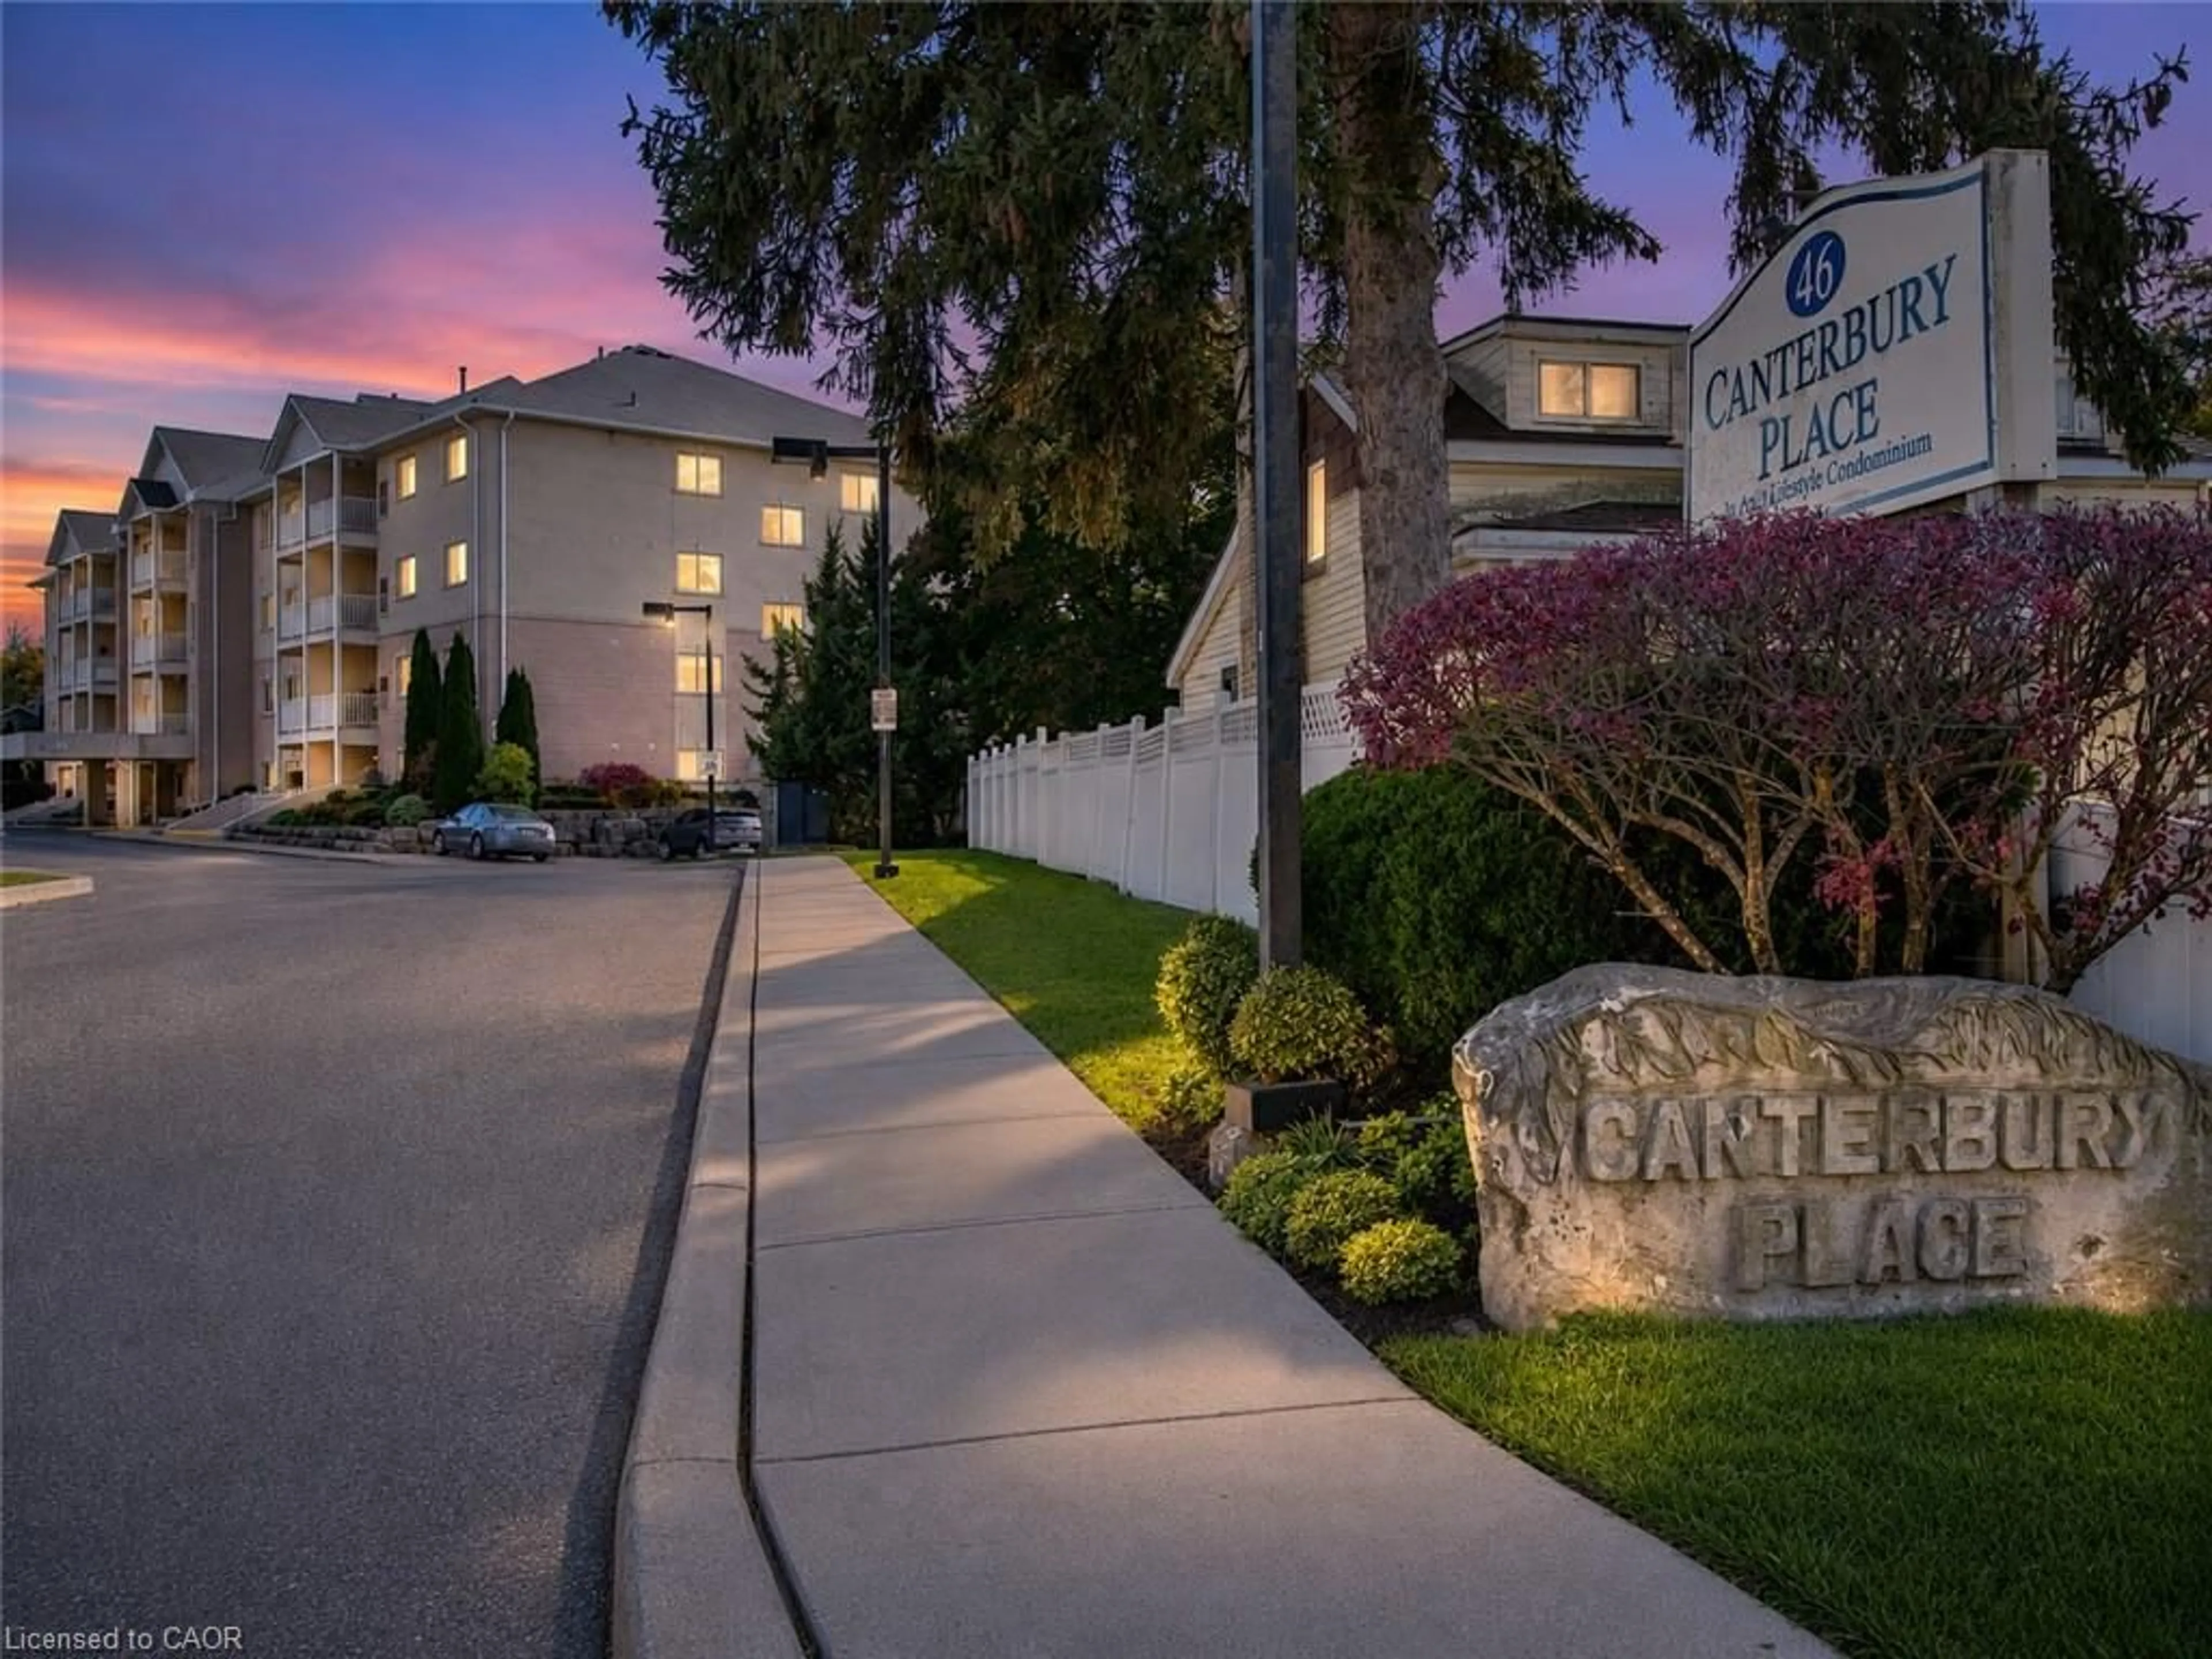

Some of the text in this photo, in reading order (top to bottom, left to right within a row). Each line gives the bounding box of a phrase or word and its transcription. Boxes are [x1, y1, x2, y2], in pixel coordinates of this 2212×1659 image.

[1794, 240, 1834, 306] 46
[1706, 252, 1957, 431] CANTERBURY
[1757, 377, 1880, 480] PLACE
[1826, 433, 1933, 485] Condominium
[1586, 1091, 2161, 1180] CANTERBURY
[1740, 1199, 2028, 1290] PLACE
